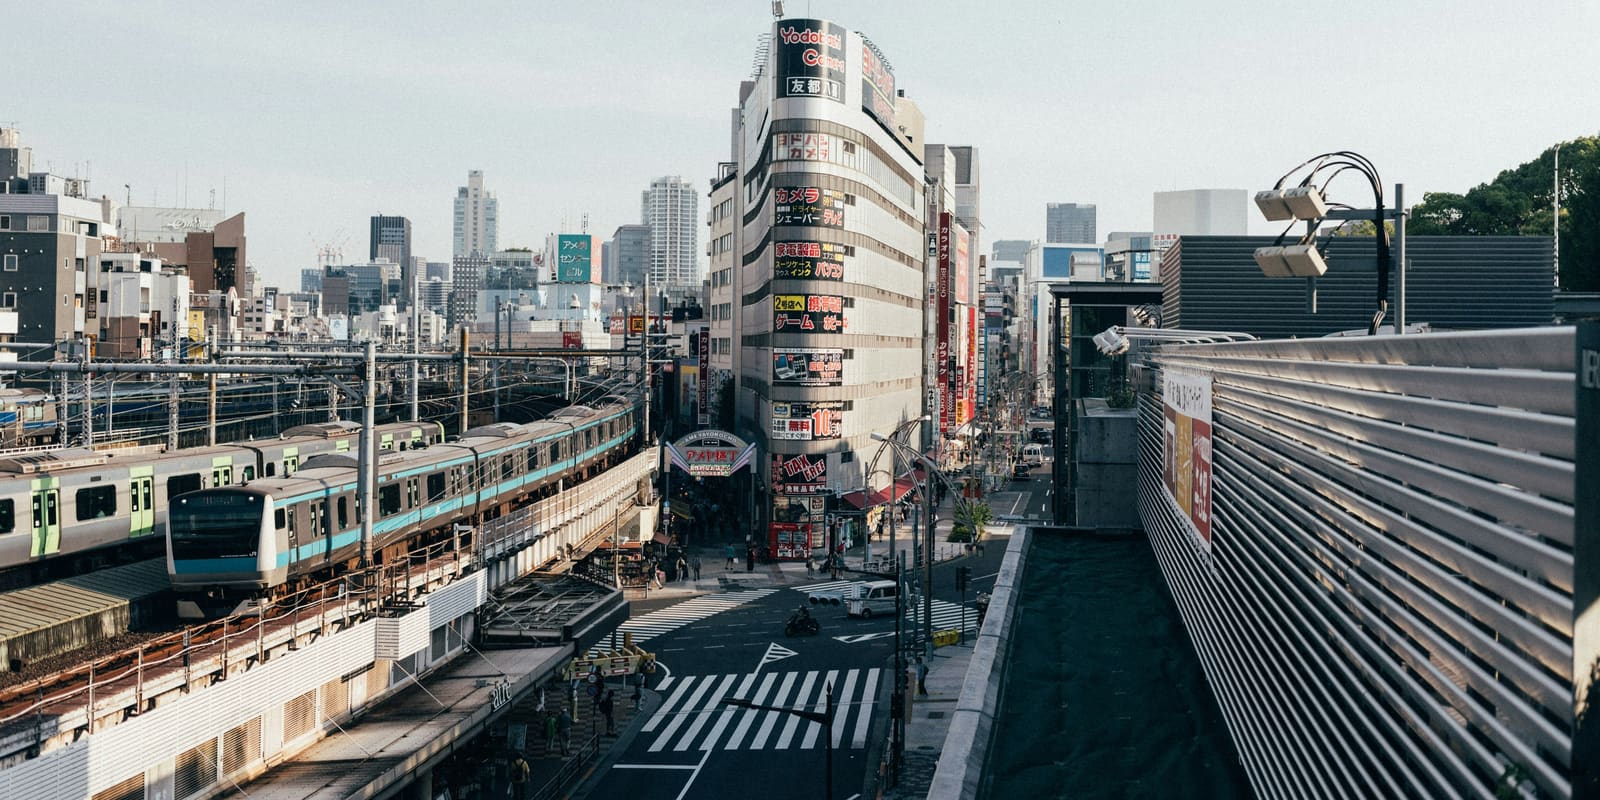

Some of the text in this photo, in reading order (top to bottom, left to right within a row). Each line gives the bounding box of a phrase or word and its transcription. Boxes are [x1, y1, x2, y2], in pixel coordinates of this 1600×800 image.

[778, 134, 828, 146] ヨドバシ
[790, 147, 828, 159] カメラ
[776, 187, 820, 204] カメラ
[792, 205, 822, 213] ドライヤー
[776, 213, 821, 224] シェーバー
[776, 242, 820, 257] 家電製品
[775, 261, 812, 269] スーツケース
[790, 268, 812, 277] インク
[776, 313, 815, 330] ゲーム
[811, 408, 831, 437] 10
[783, 453, 812, 477] TAX
[802, 458, 826, 482] FREE
